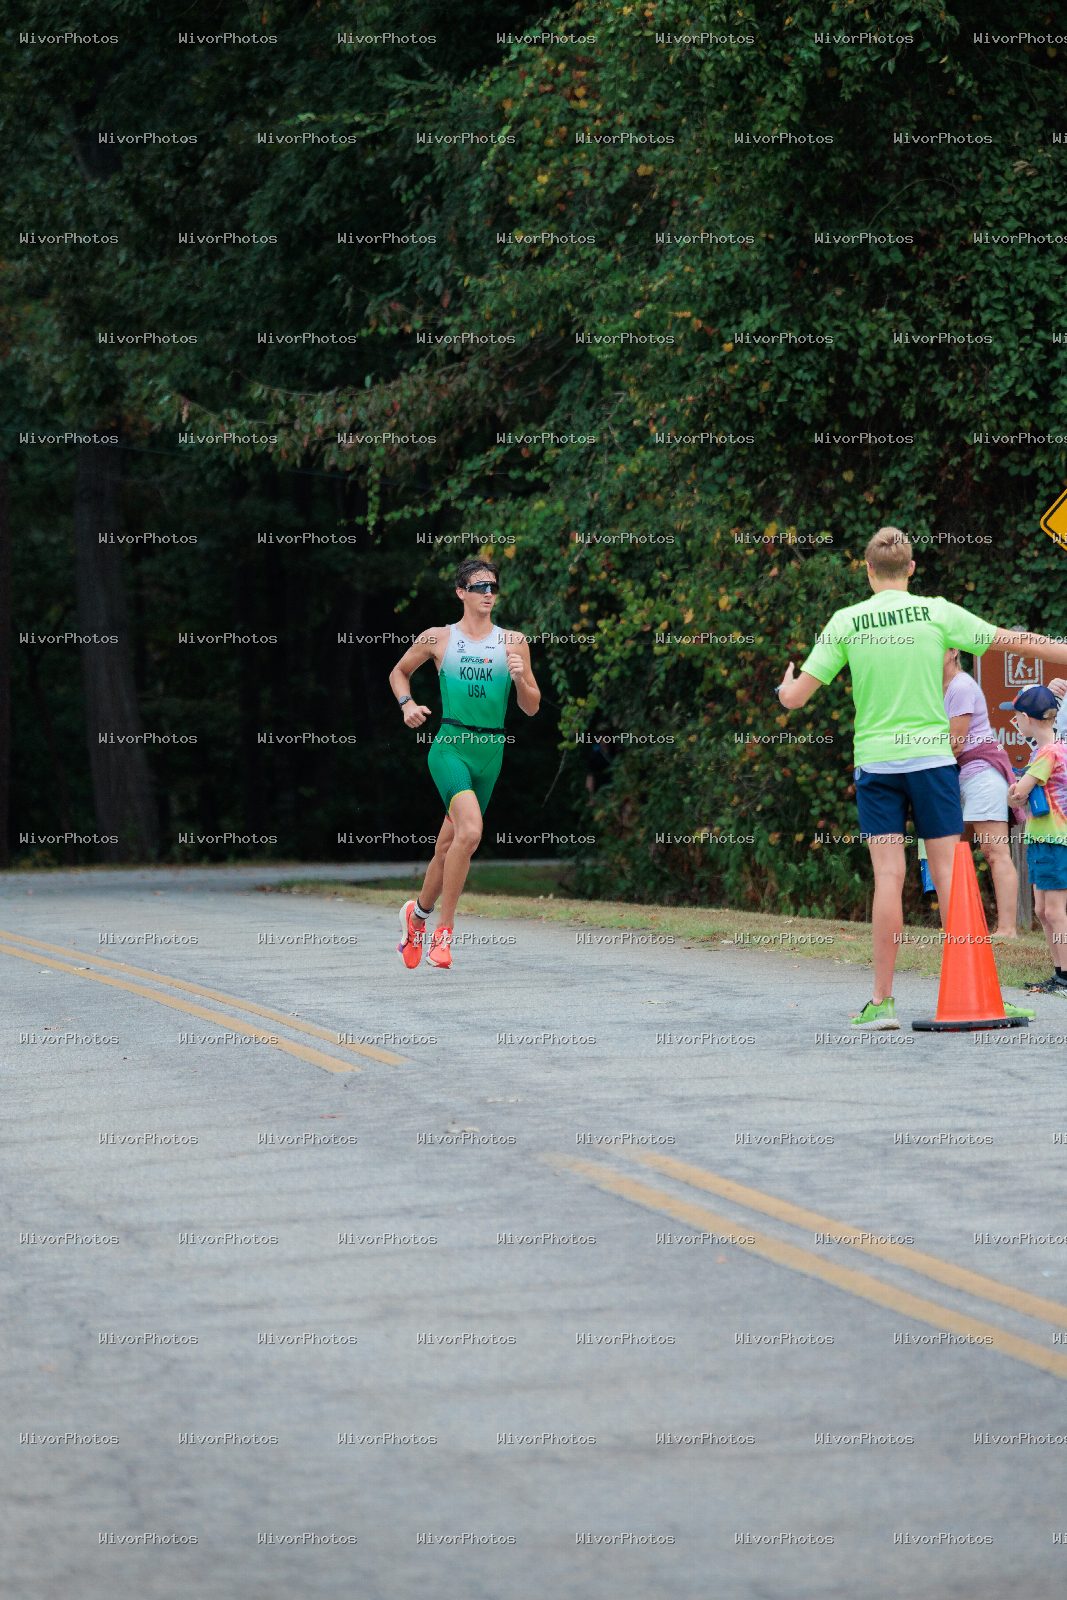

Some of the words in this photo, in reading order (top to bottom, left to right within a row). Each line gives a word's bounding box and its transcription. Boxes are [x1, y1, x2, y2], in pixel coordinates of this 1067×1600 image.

[852, 606, 931, 632] VOLUNTEER
[460, 666, 493, 681] KOVAK
[467, 684, 486, 698] USA
